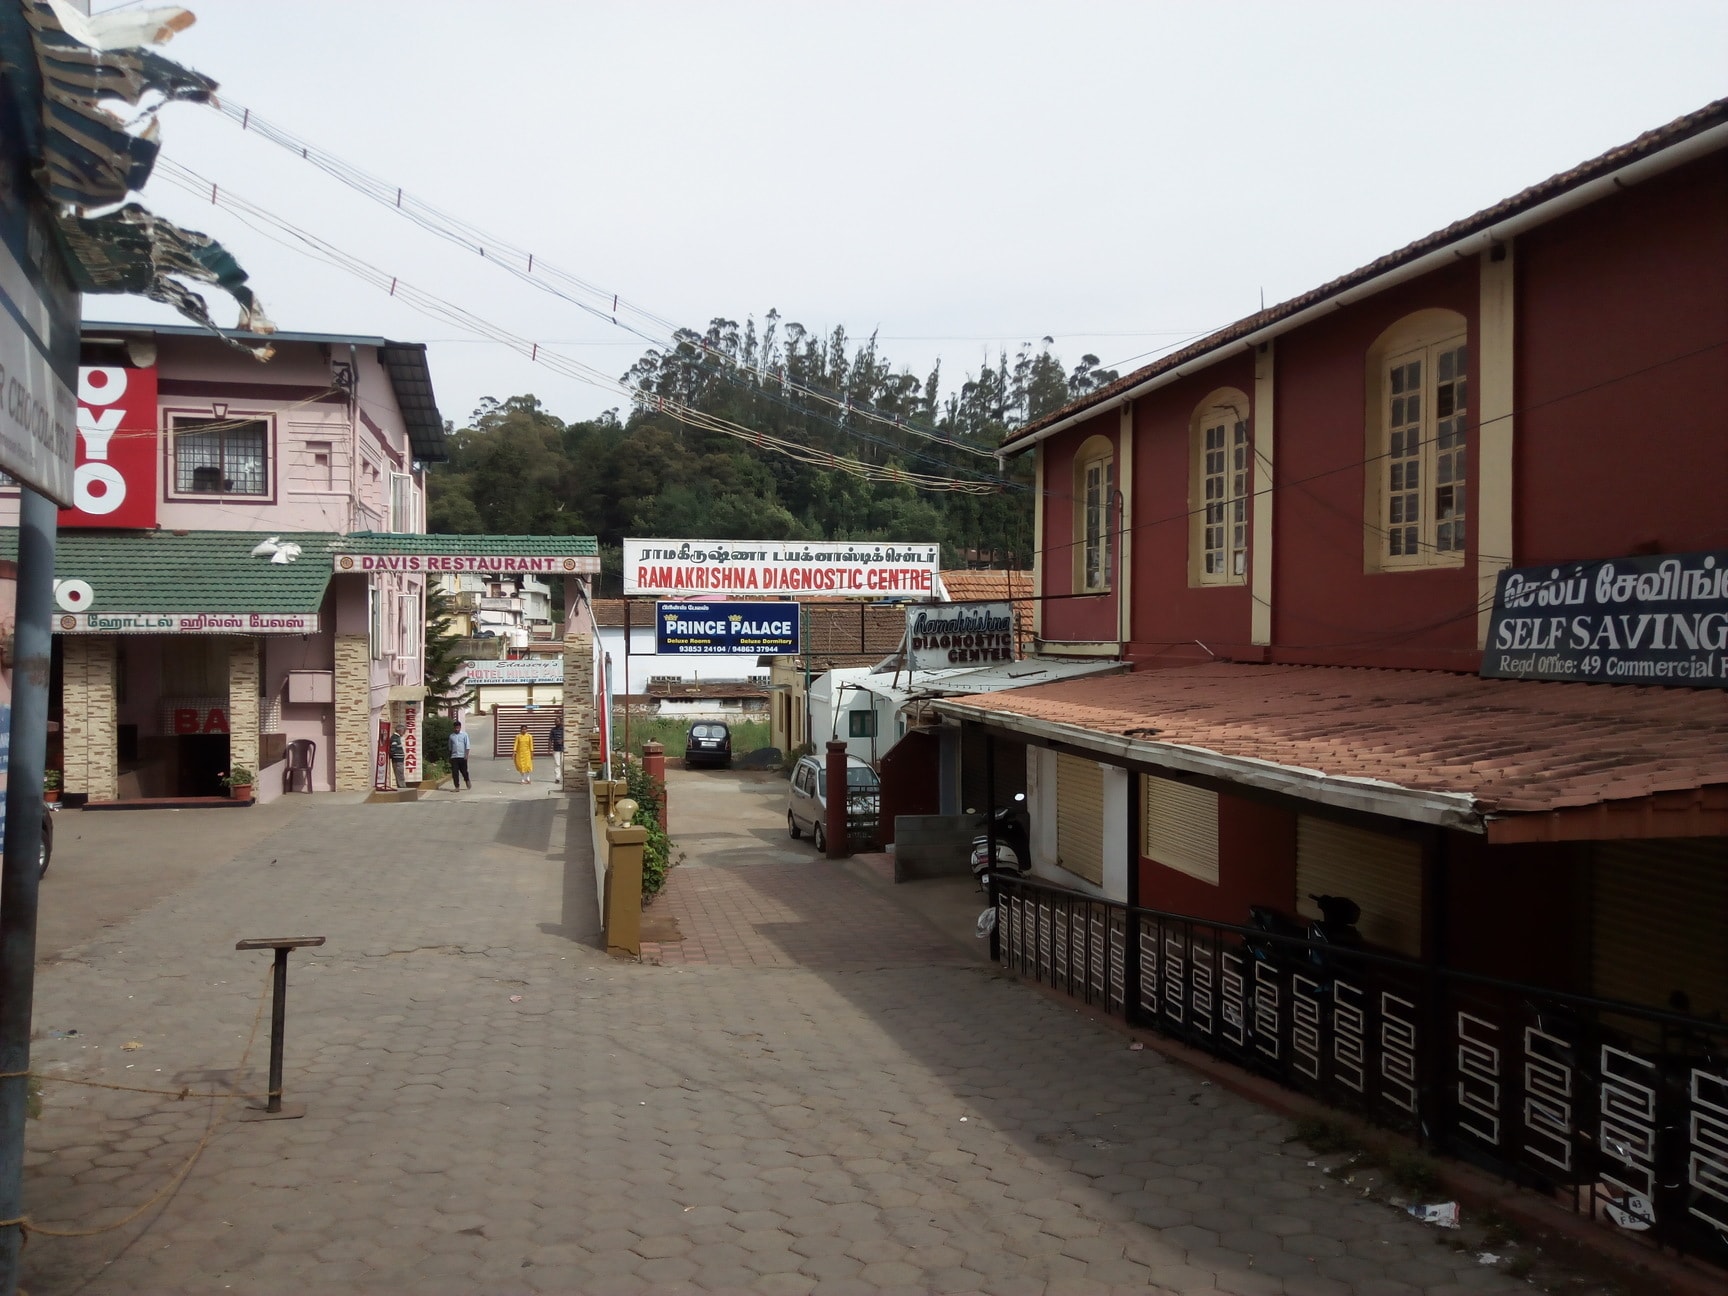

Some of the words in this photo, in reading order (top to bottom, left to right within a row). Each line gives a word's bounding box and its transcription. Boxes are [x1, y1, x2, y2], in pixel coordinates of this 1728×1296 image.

[73, 366, 128, 515] OYO
[362, 556, 420, 571] DAVIS
[427, 557, 555, 571] RESTAURANT
[637, 566, 758, 589] RAMAKRISHNA
[763, 567, 863, 590] DIAGNOSTIC
[867, 569, 931, 590] CENTRE
[1595, 555, 1728, 604] சேவிங்
[87, 614, 173, 631] ஹோட்டல்
[180, 614, 243, 631] ஹில்ஸ்
[249, 614, 305, 629] பேலஸ்
[666, 621, 727, 635] PRINCE
[730, 621, 792, 635] PALACE
[913, 610, 1011, 635] Ramakrishna
[1496, 616, 1567, 650] SELF
[912, 633, 1012, 650] DIAGNOSTIC
[948, 647, 1013, 663] CENTER
[1499, 653, 1536, 678] Regd
[1580, 655, 1601, 675] 49
[1606, 652, 1714, 678] Commercial
[467, 669, 503, 678] HOTEL
[405, 708, 417, 774] RESTAURANT
